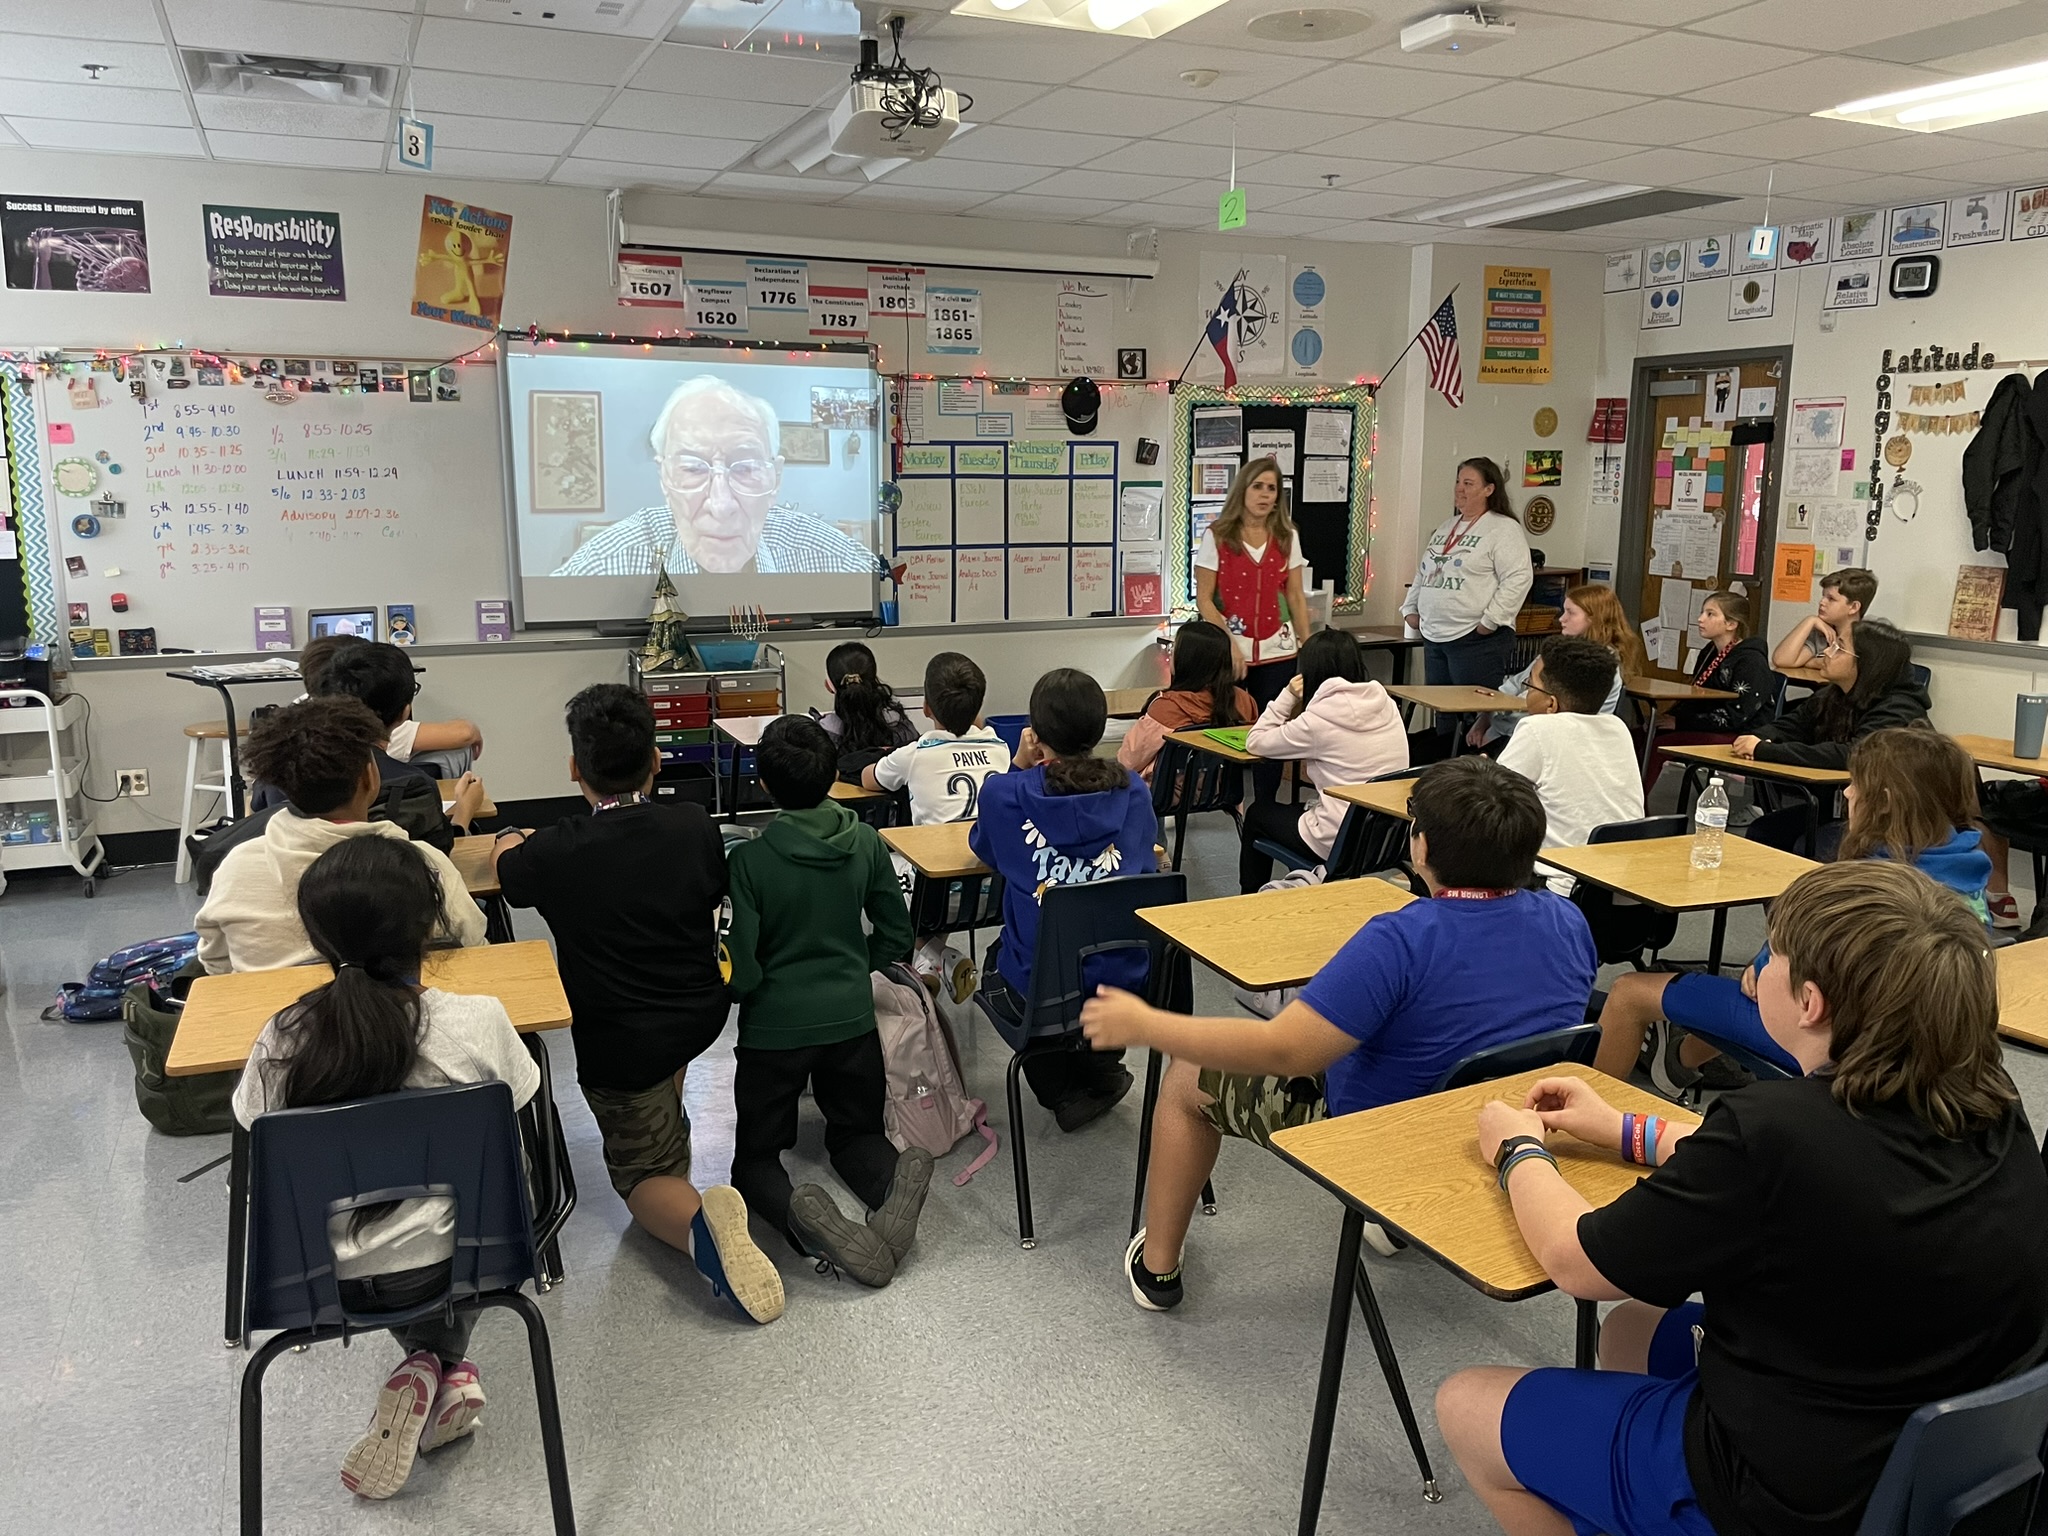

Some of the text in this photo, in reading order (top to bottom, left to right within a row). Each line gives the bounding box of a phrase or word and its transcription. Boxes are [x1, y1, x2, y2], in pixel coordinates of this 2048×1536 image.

[408, 135, 420, 156] 3
[6, 201, 42, 212] Success
[54, 204, 96, 214] measured
[98, 206, 108, 215] by
[111, 207, 136, 216] effort.
[1224, 197, 1238, 223] 2
[429, 200, 508, 231] Your Actions
[430, 216, 453, 228] speak
[456, 220, 482, 234] louder
[1791, 222, 1824, 233] Thematic
[1798, 230, 1814, 238] Map
[1952, 228, 2001, 241] Freshwater
[1760, 236, 1765, 250] 1
[1842, 240, 1874, 250] Absolute
[1891, 238, 1941, 251] Infrastructure
[1840, 247, 1874, 257] Location
[1503, 269, 1532, 278] Classroom
[1689, 268, 1727, 279] Hemisphere
[1740, 262, 1768, 272] Latitude
[755, 276, 799, 285] Independence
[1499, 277, 1537, 286] Expectations
[1653, 275, 1676, 283] Equator
[631, 282, 672, 297] 1607
[698, 288, 732, 296] Mayflower
[1836, 290, 1868, 299] Relative
[761, 291, 796, 304] 1776
[879, 297, 916, 309] 1803
[1834, 297, 1868, 306] Location
[416, 301, 448, 318] Your
[1734, 306, 1767, 316] Longitude
[697, 312, 737, 325] 1620
[821, 314, 857, 327] 1787
[1270, 312, 1279, 324] E
[936, 328, 972, 340] 1865
[1237, 350, 1245, 363] S
[1882, 342, 1995, 373] Latitude
[1500, 366, 1524, 374] another
[144, 422, 164, 442] 2nd
[272, 425, 285, 445] 1/2
[146, 443, 166, 462] 3rd
[1010, 441, 1066, 456] Wednesday
[904, 453, 945, 468] Monday
[960, 453, 1000, 468] Tuesday
[1012, 456, 1059, 473] Thursday
[1080, 453, 1110, 468] Friday
[146, 465, 181, 478] Lunch
[277, 468, 324, 480] LUNCH
[272, 486, 292, 500] 5/6
[150, 501, 172, 518] 5th
[281, 510, 337, 530] Advisory
[153, 522, 172, 540] 6th
[1430, 534, 1482, 548] SLGH
[952, 750, 990, 767] PAYNE
[1461, 890, 1488, 899] LAMAR
